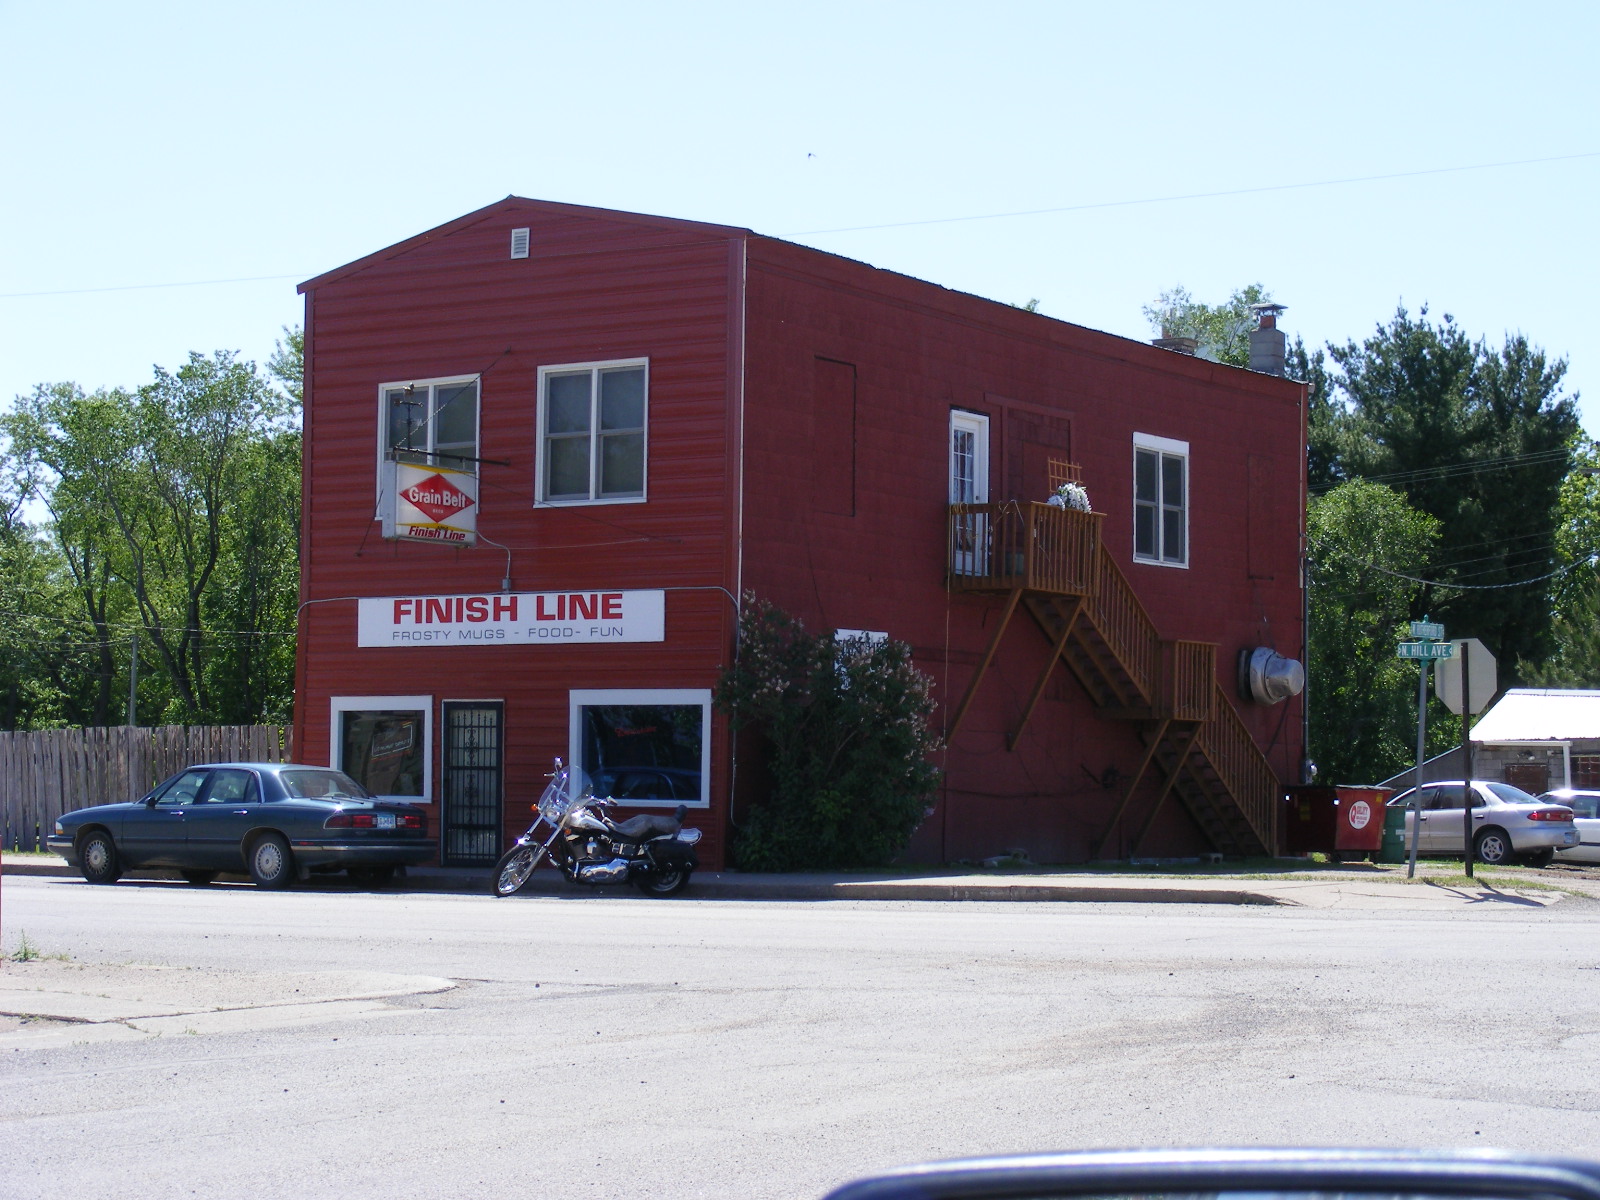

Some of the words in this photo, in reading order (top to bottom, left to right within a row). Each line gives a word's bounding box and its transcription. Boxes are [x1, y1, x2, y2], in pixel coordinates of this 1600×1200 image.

[409, 486, 441, 505] Grain
[442, 490, 466, 508] Belt
[408, 525, 441, 538] Finish
[443, 528, 466, 541] Line
[393, 596, 518, 624] FINISH
[536, 593, 623, 621] LINE
[392, 630, 451, 640] FROSTY
[458, 629, 505, 640] MUGS
[590, 626, 624, 637] FUN
[1401, 645, 1409, 657] N.
[1411, 645, 1429, 657] HILL
[1431, 645, 1449, 657] AVE.
